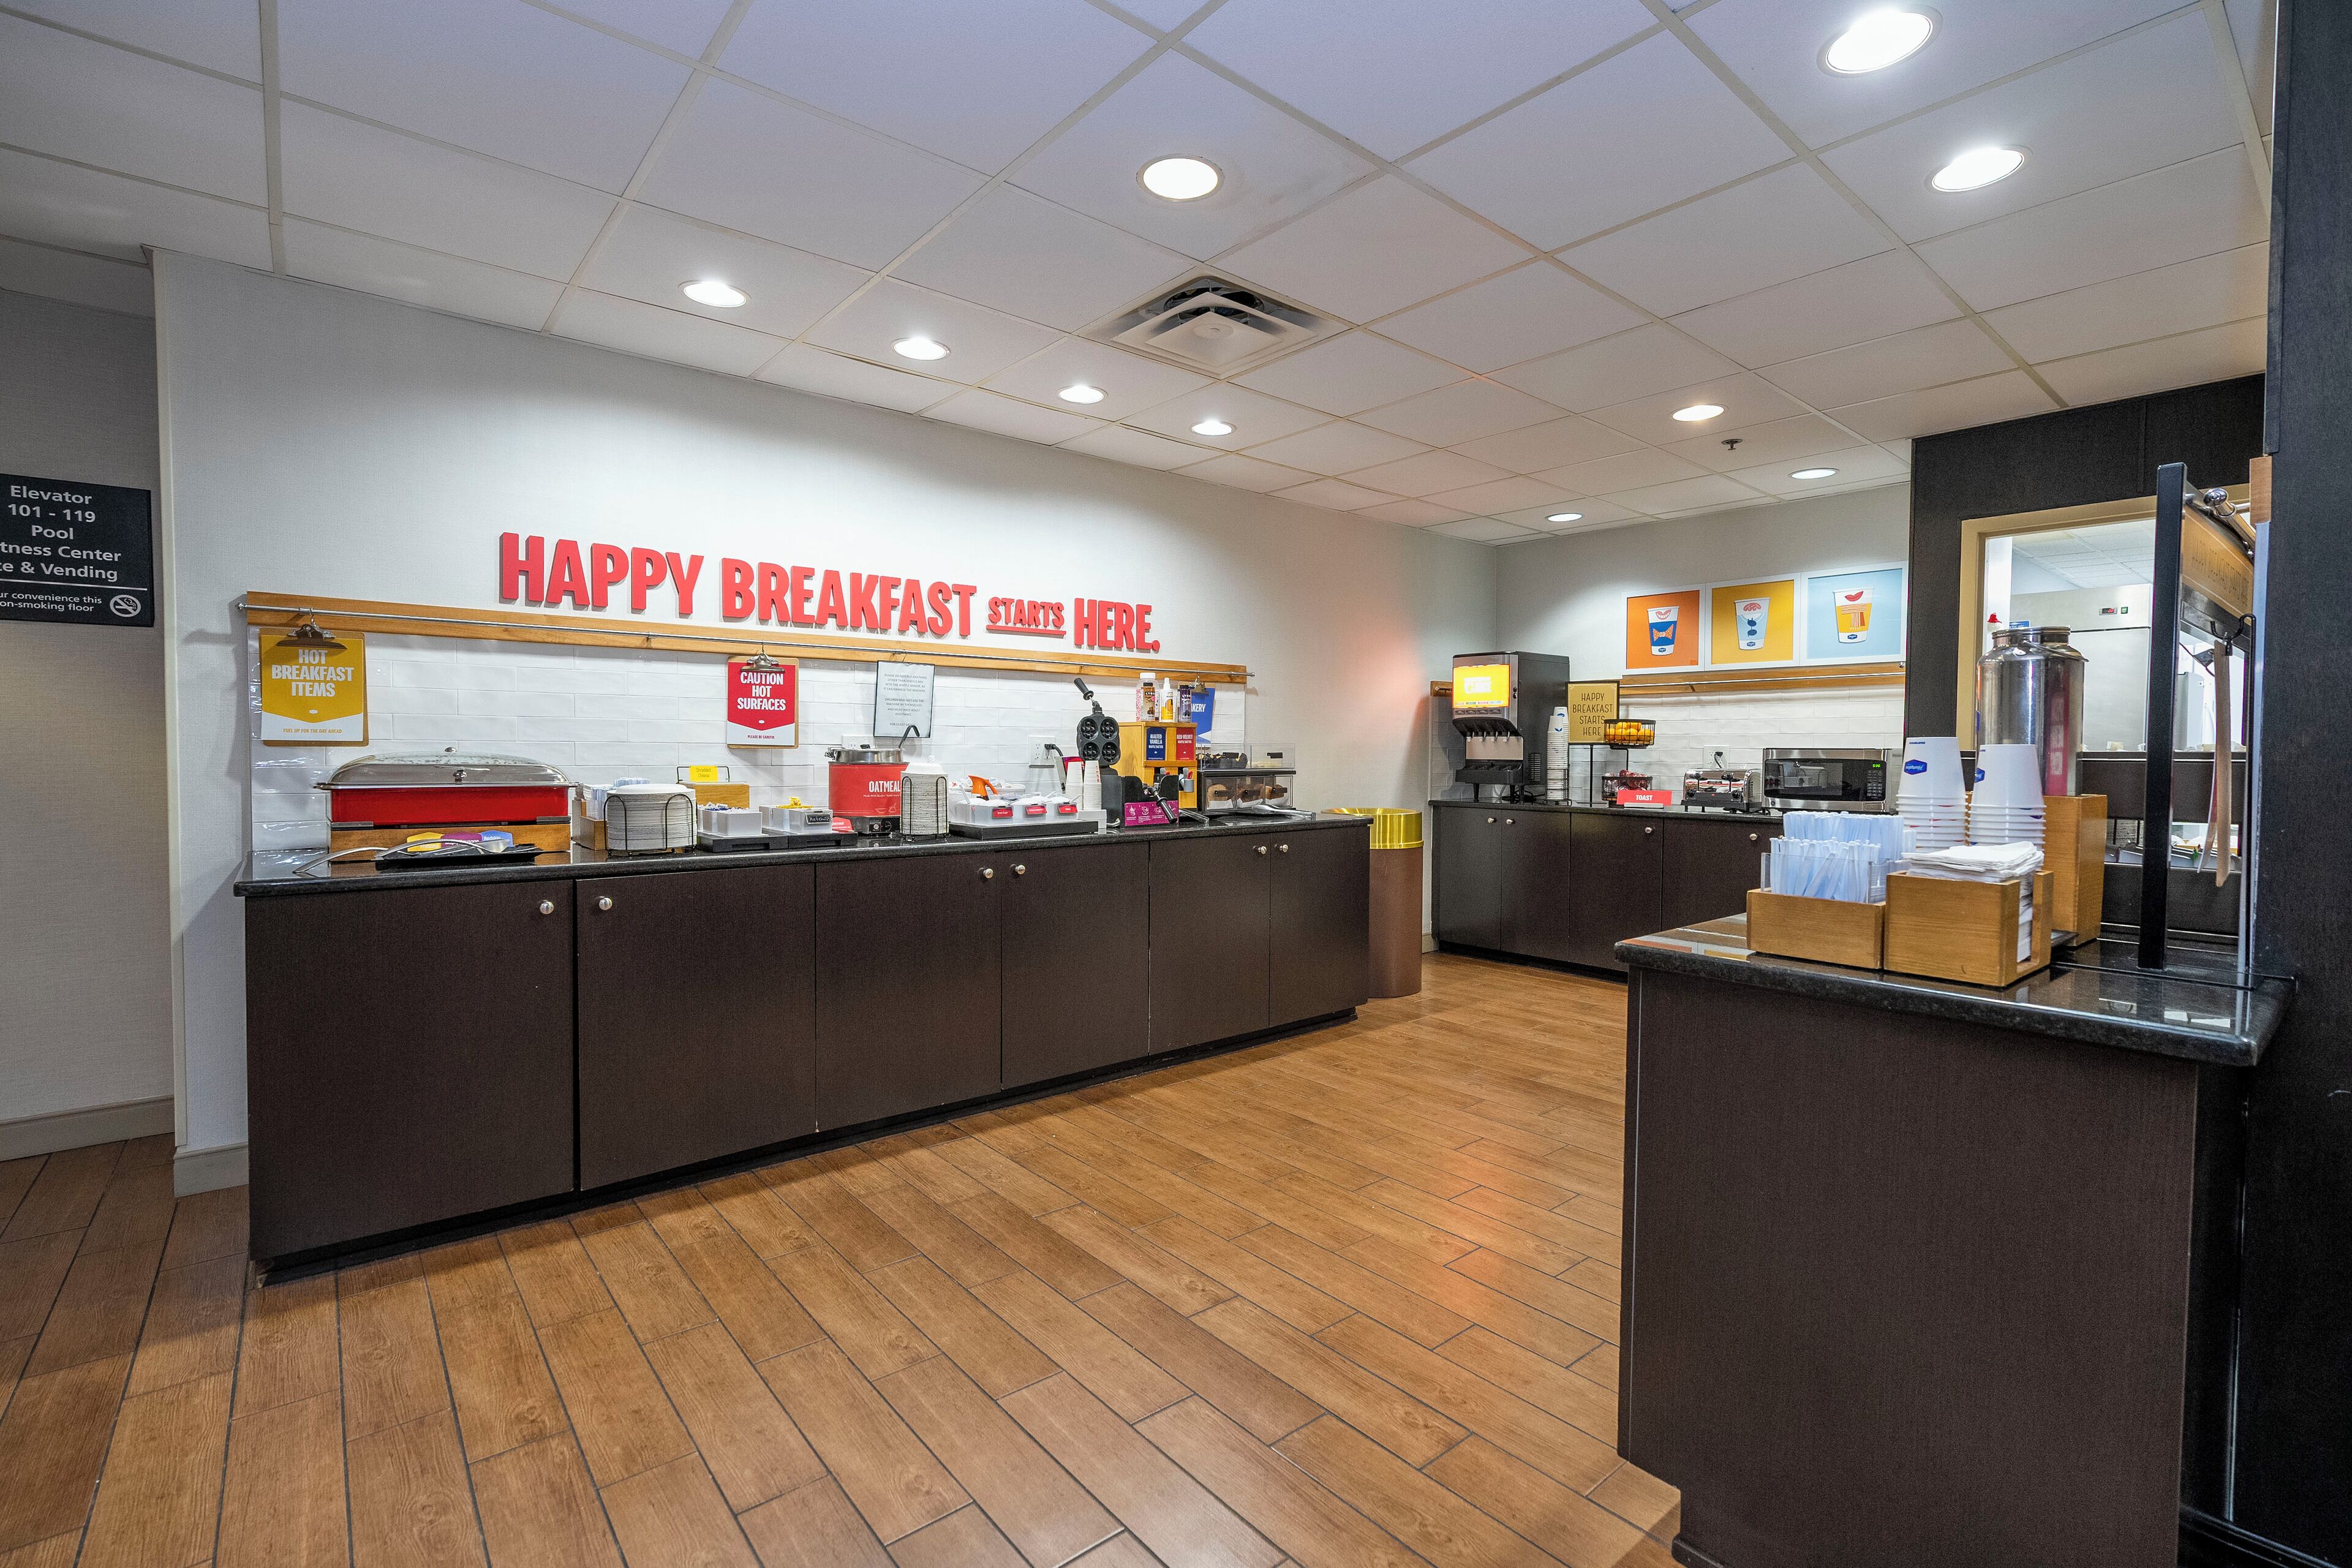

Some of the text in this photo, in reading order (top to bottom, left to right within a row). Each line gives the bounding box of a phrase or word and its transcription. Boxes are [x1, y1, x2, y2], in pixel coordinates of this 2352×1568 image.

[10, 485, 92, 504] Elevator
[8, 503, 40, 518] 101
[62, 509, 96, 522] 119
[31, 525, 74, 540] Pool
[58, 546, 121, 561] Center
[20, 562, 35, 574] &
[40, 563, 118, 582] Vending
[12, 593, 80, 603] convenience
[500, 532, 1161, 652] HAPPY BREAKFAST STARTS HERE.
[0, 601, 94, 612] on-smoking floor
[298, 649, 328, 665] HOT
[271, 665, 354, 682] BREAKFAST
[740, 672, 784, 685] CAUTION
[292, 681, 336, 697] ITEMS
[752, 685, 772, 698] HOT
[1581, 692, 1605, 701] HAPPY
[737, 697, 786, 710] SURFACES
[1191, 703, 1206, 712] KERY
[1572, 704, 1613, 713] BREAKFAST
[1579, 715, 1605, 725] STARTS
[1583, 726, 1601, 736] HERE
[869, 780, 901, 793] OATMEAL
